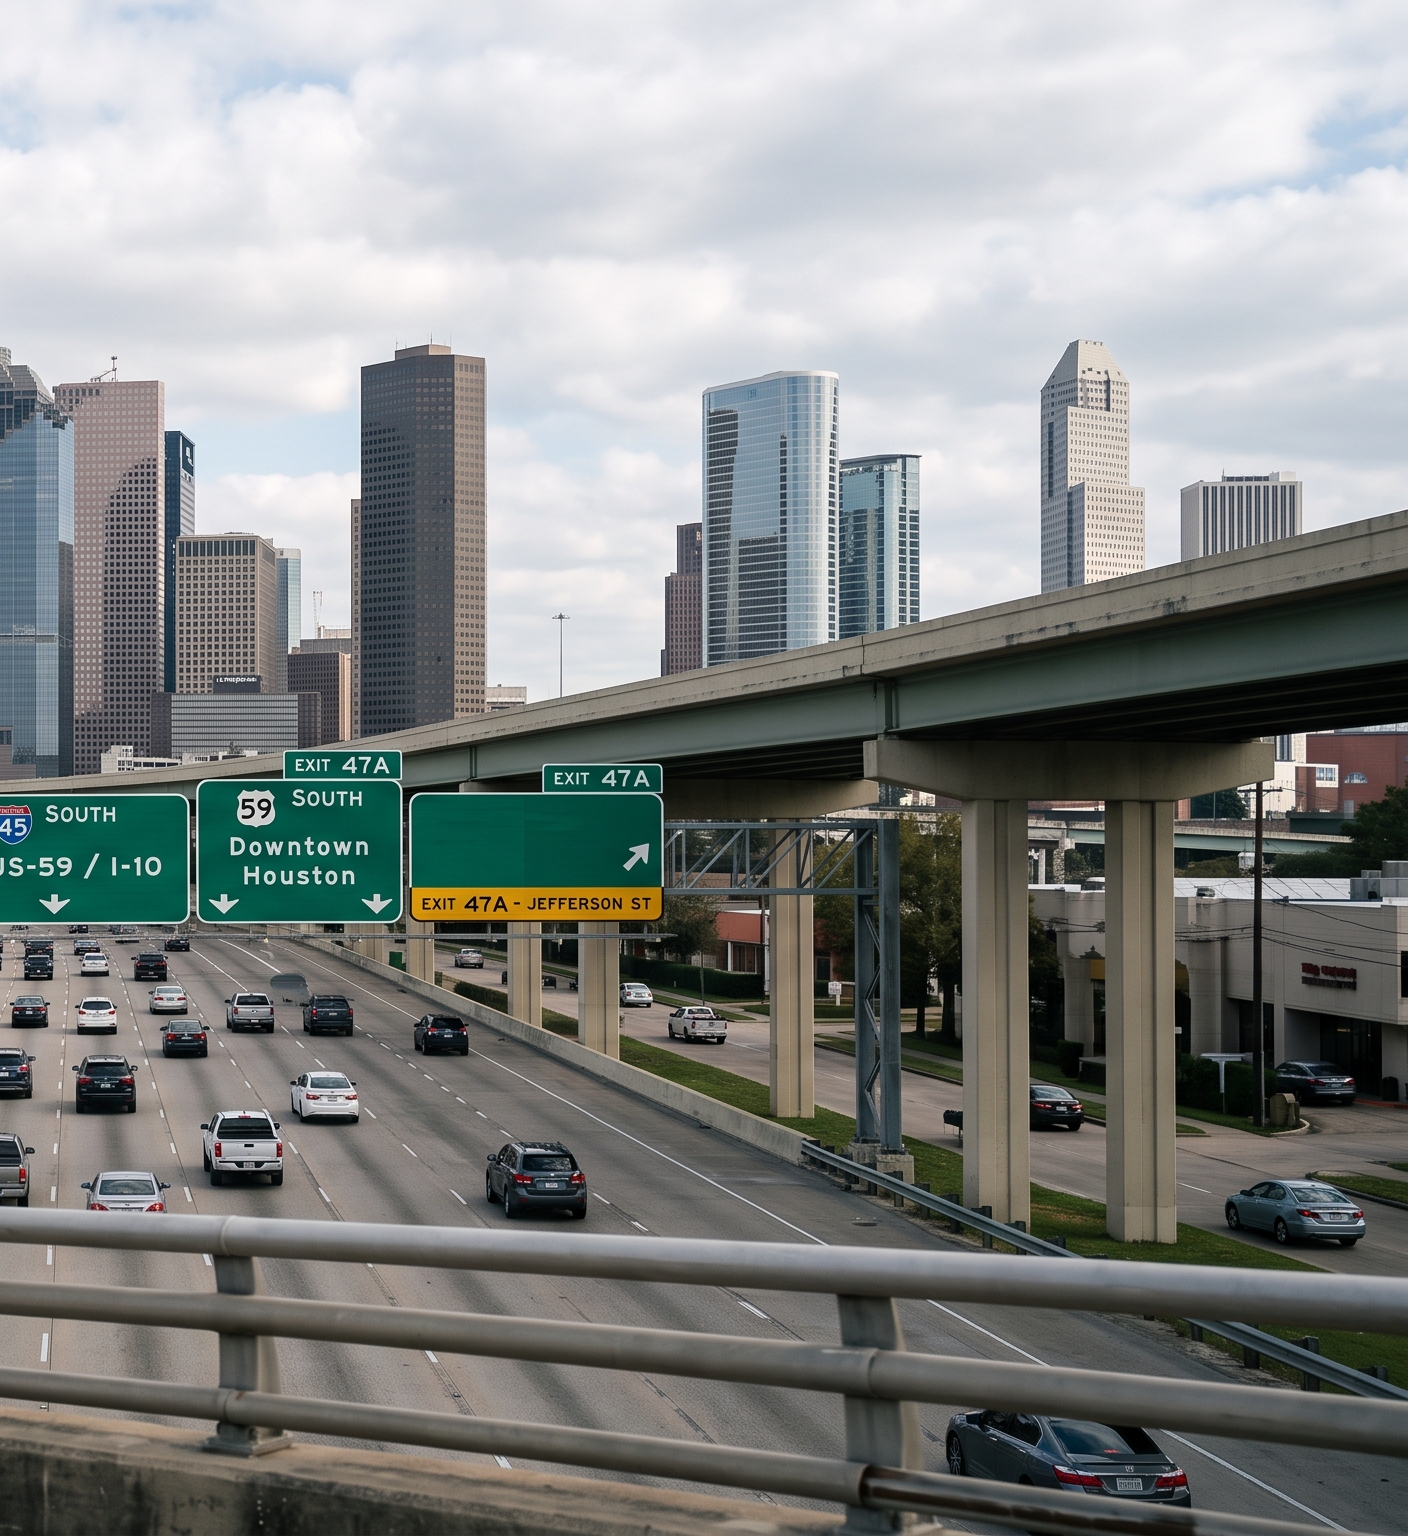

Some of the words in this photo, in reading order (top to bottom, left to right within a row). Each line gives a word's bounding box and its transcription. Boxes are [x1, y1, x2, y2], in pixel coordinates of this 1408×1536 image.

[295, 758, 331, 772] EXIT
[341, 756, 390, 774] 47A
[554, 772, 590, 786] EXIT
[601, 769, 650, 787] 47A
[291, 788, 362, 807] SOUTH
[45, 804, 116, 823] SOUTH
[241, 798, 272, 820] 59
[230, 836, 369, 856] Downtown
[83, 853, 100, 879] /
[243, 865, 355, 885] Houston
[422, 897, 456, 911] EXIT
[464, 895, 508, 913] 47A
[527, 897, 623, 911] JEFFERSON
[631, 897, 652, 911] ST
